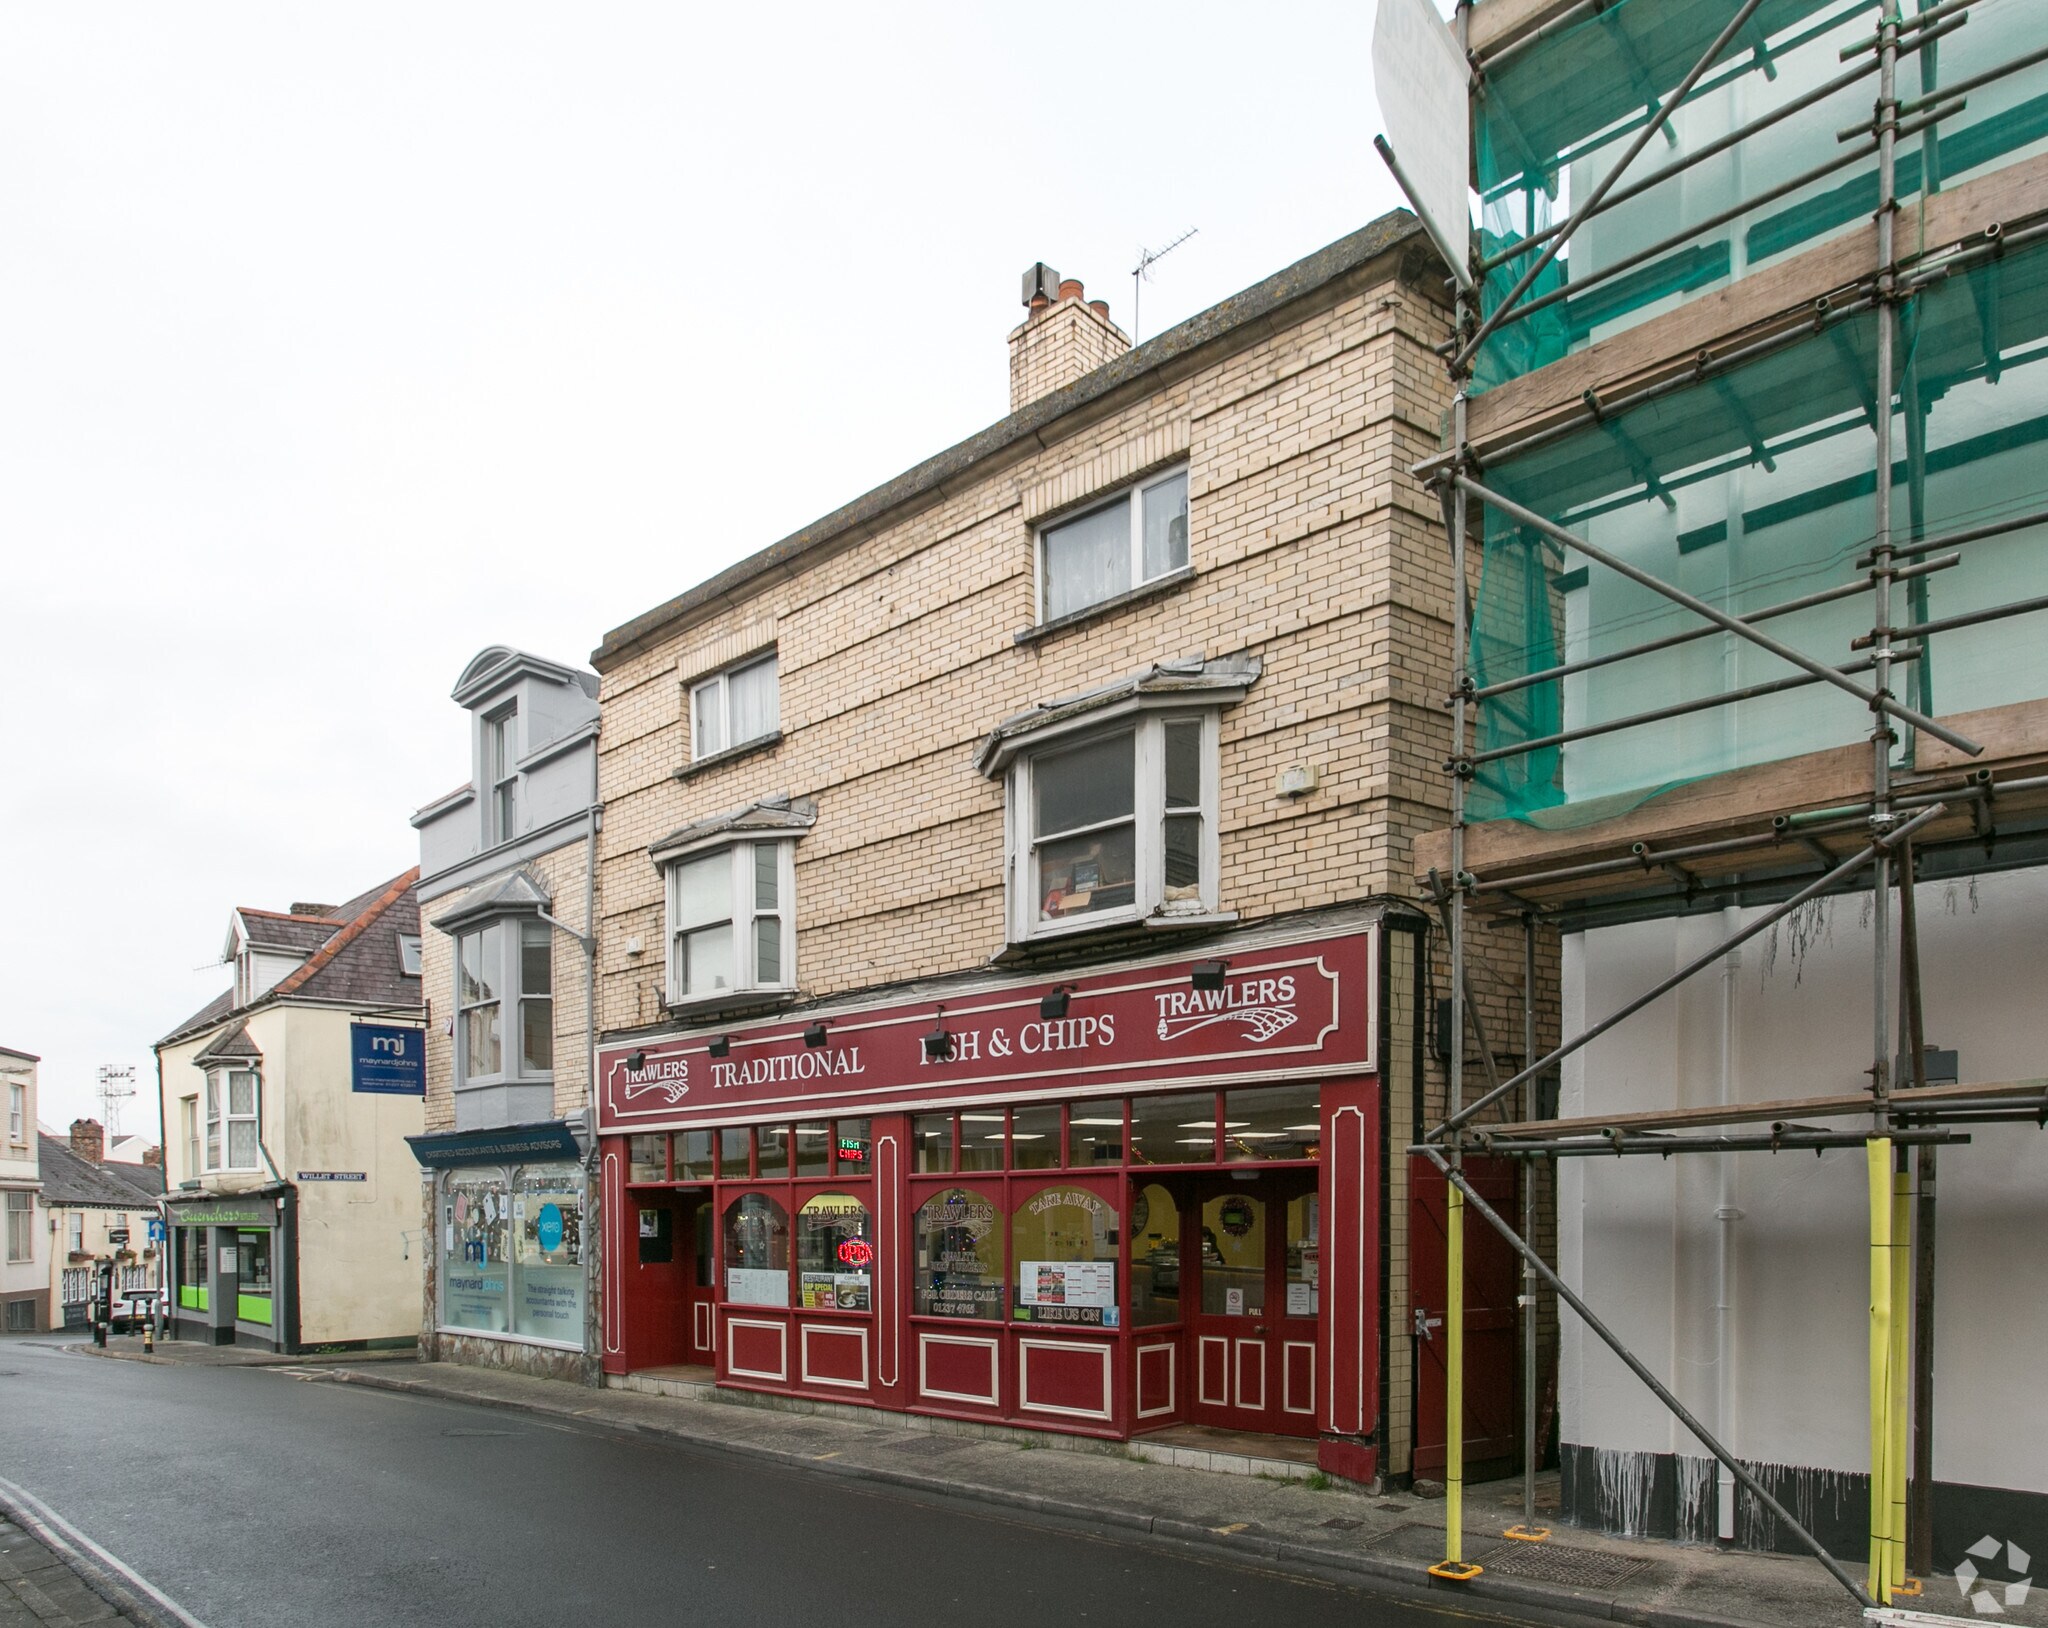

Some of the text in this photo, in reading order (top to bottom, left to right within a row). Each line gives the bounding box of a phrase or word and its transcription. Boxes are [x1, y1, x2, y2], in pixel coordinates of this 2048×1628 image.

[1154, 975, 1296, 1018] TRAWLERS
[372, 1034, 405, 1056] mj
[918, 1014, 1115, 1066] FSH & CHIPS
[359, 1057, 418, 1067] maynardjohns
[710, 1047, 865, 1089] TRADITIONAL
[623, 1060, 688, 1083] TRAWLERS
[455, 1145, 496, 1157] ACCOUNTANTS
[501, 1143, 530, 1153] BUSINESS
[530, 1139, 562, 1151] ADVISORS
[839, 1148, 863, 1160] CHIPS
[926, 1203, 994, 1220] TRAWLERS
[1029, 1192, 1102, 1215] TAKE AWAY
[180, 1205, 240, 1222] Quenchers
[806, 1205, 865, 1222] TRAWLERS
[541, 1222, 560, 1233] xero
[465, 1232, 488, 1270] mj
[838, 1243, 874, 1262] OPEN
[449, 1277, 504, 1292] maynardjohns
[527, 1283, 575, 1298] The straight talking
[815, 1283, 833, 1291] SPECIAL
[526, 1296, 576, 1308] accountants with the
[974, 1290, 998, 1302] CALL
[532, 1309, 569, 1319] personal touch
[1038, 1307, 1100, 1321] LIKE US ON
[1249, 1308, 1262, 1316] PULL
